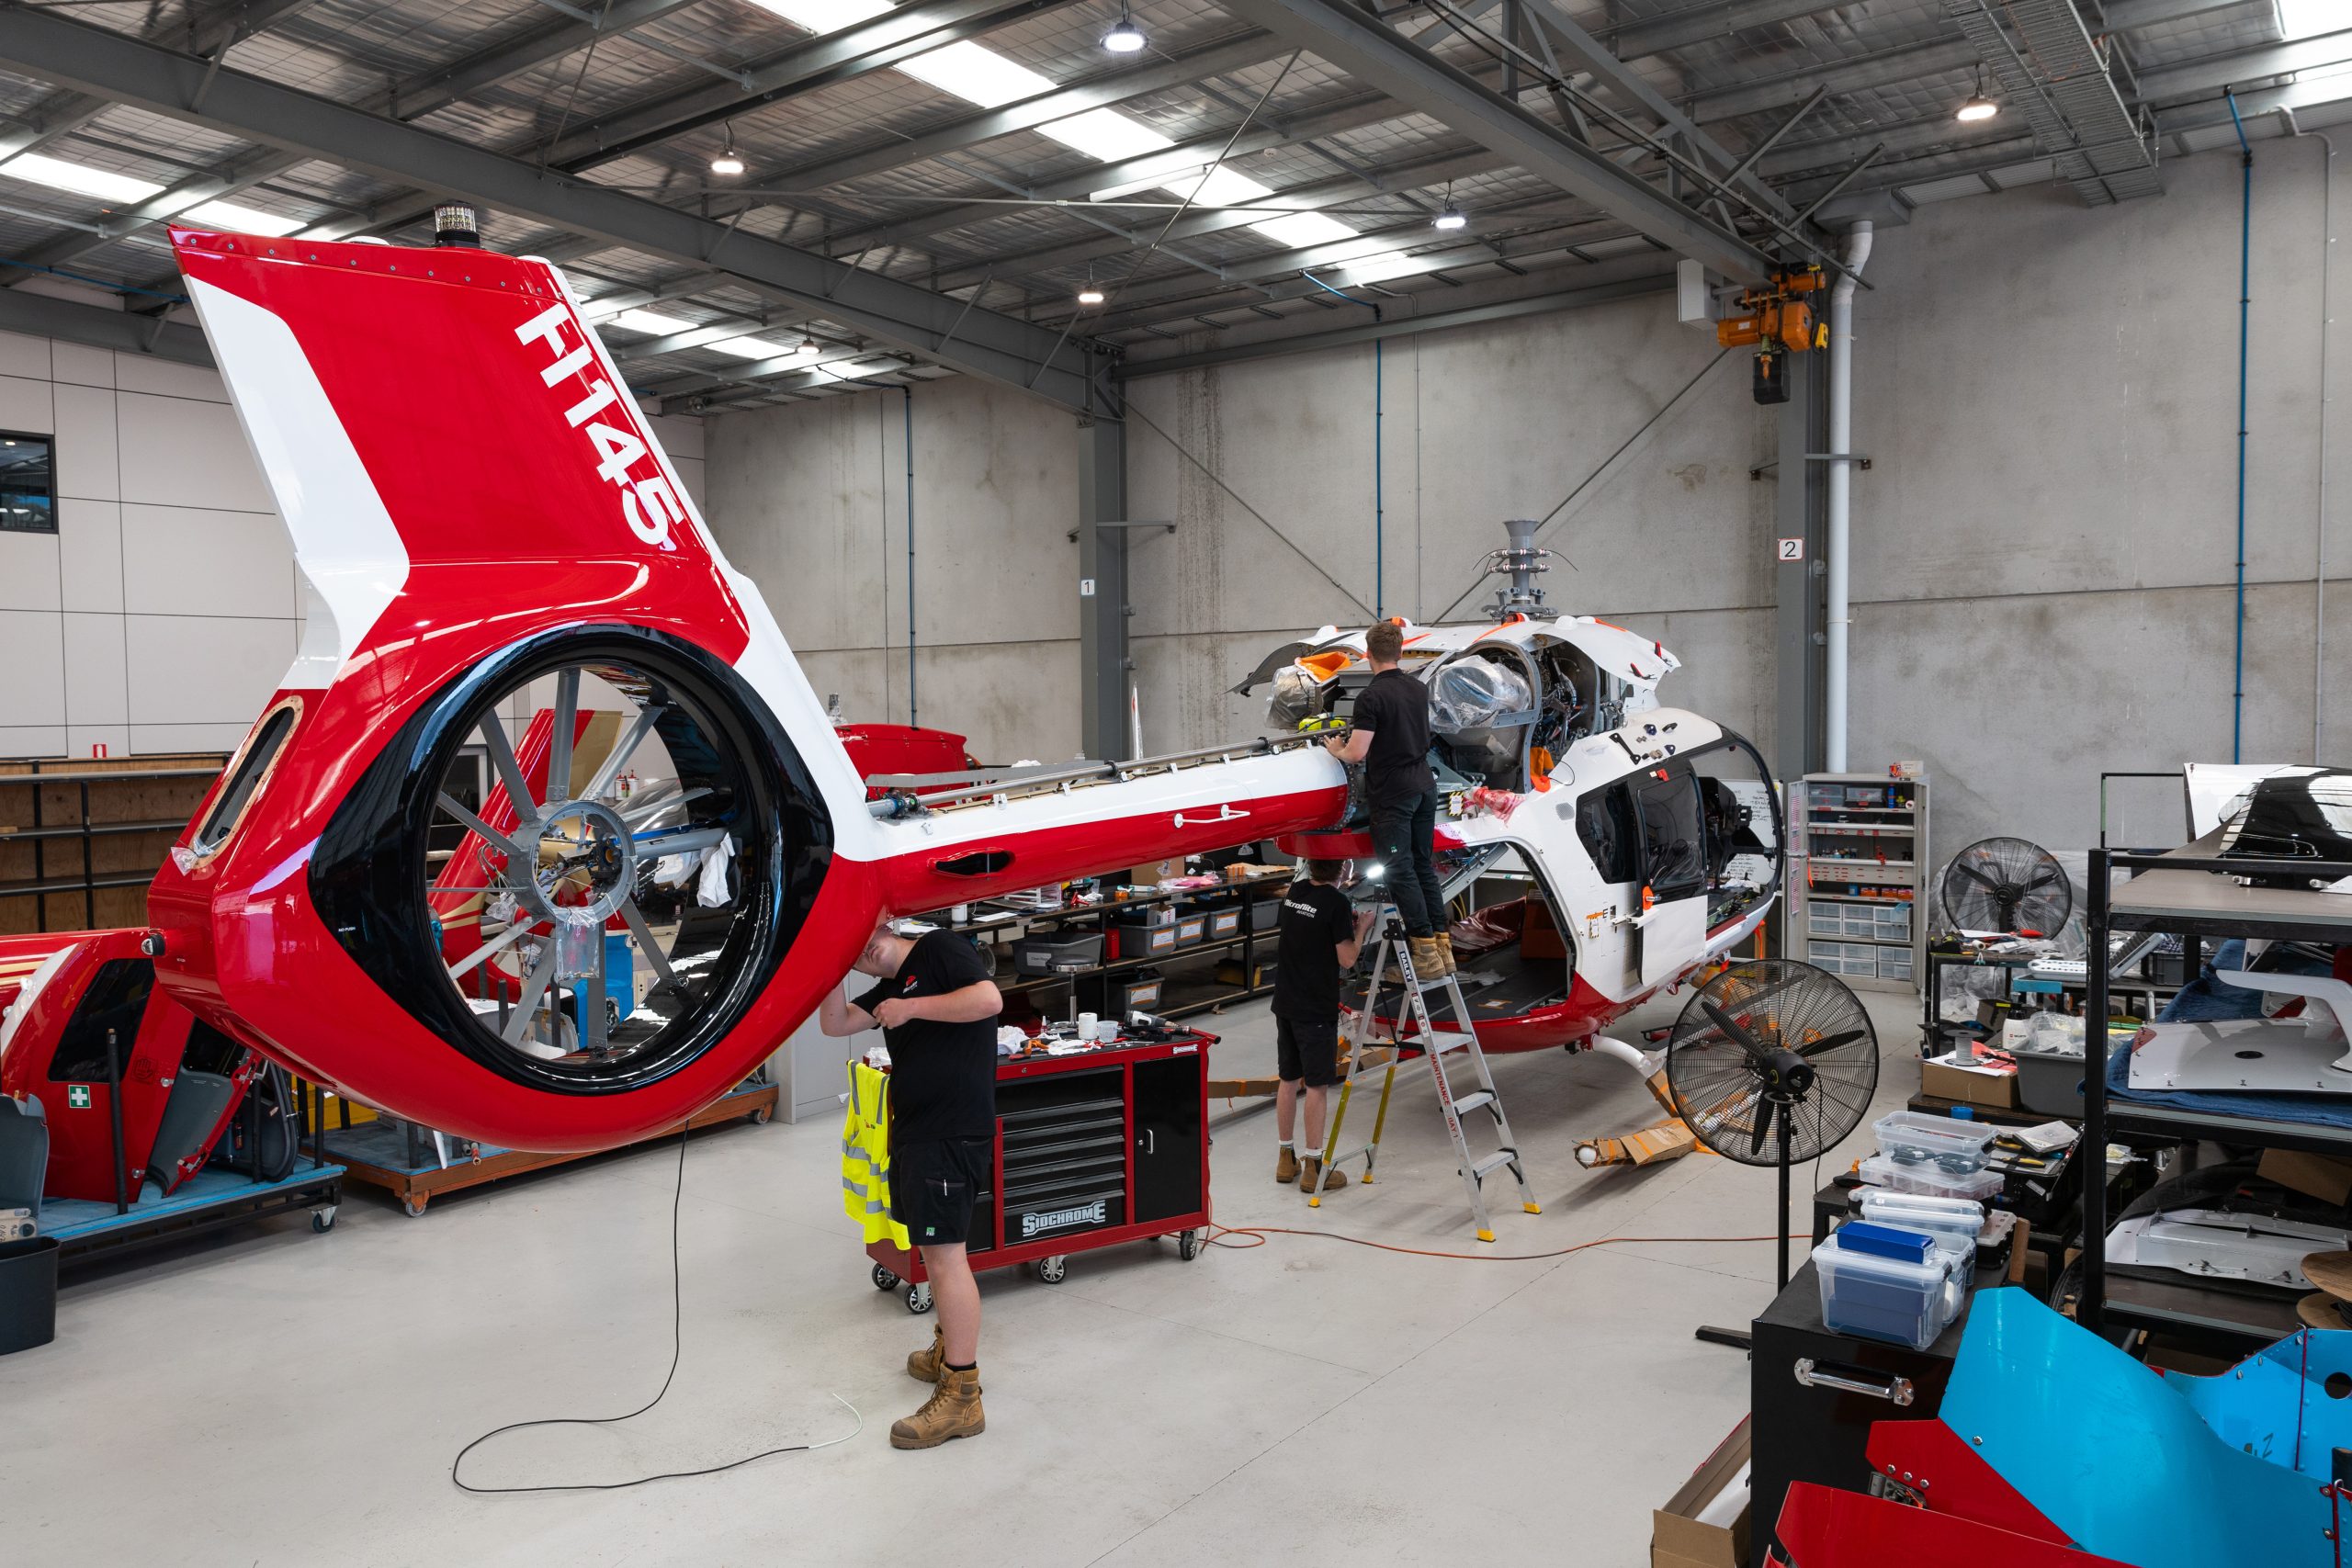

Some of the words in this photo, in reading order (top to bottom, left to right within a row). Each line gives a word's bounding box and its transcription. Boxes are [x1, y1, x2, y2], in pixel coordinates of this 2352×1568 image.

[1784, 540, 1797, 558] 2
[1084, 581, 1090, 593] 1
[1400, 953, 1413, 981] BAILEY
[1429, 1054, 1451, 1107] MAINTENANCE
[1448, 1117, 1457, 1133] BAY
[1023, 1201, 1106, 1235] SIDCHROME
